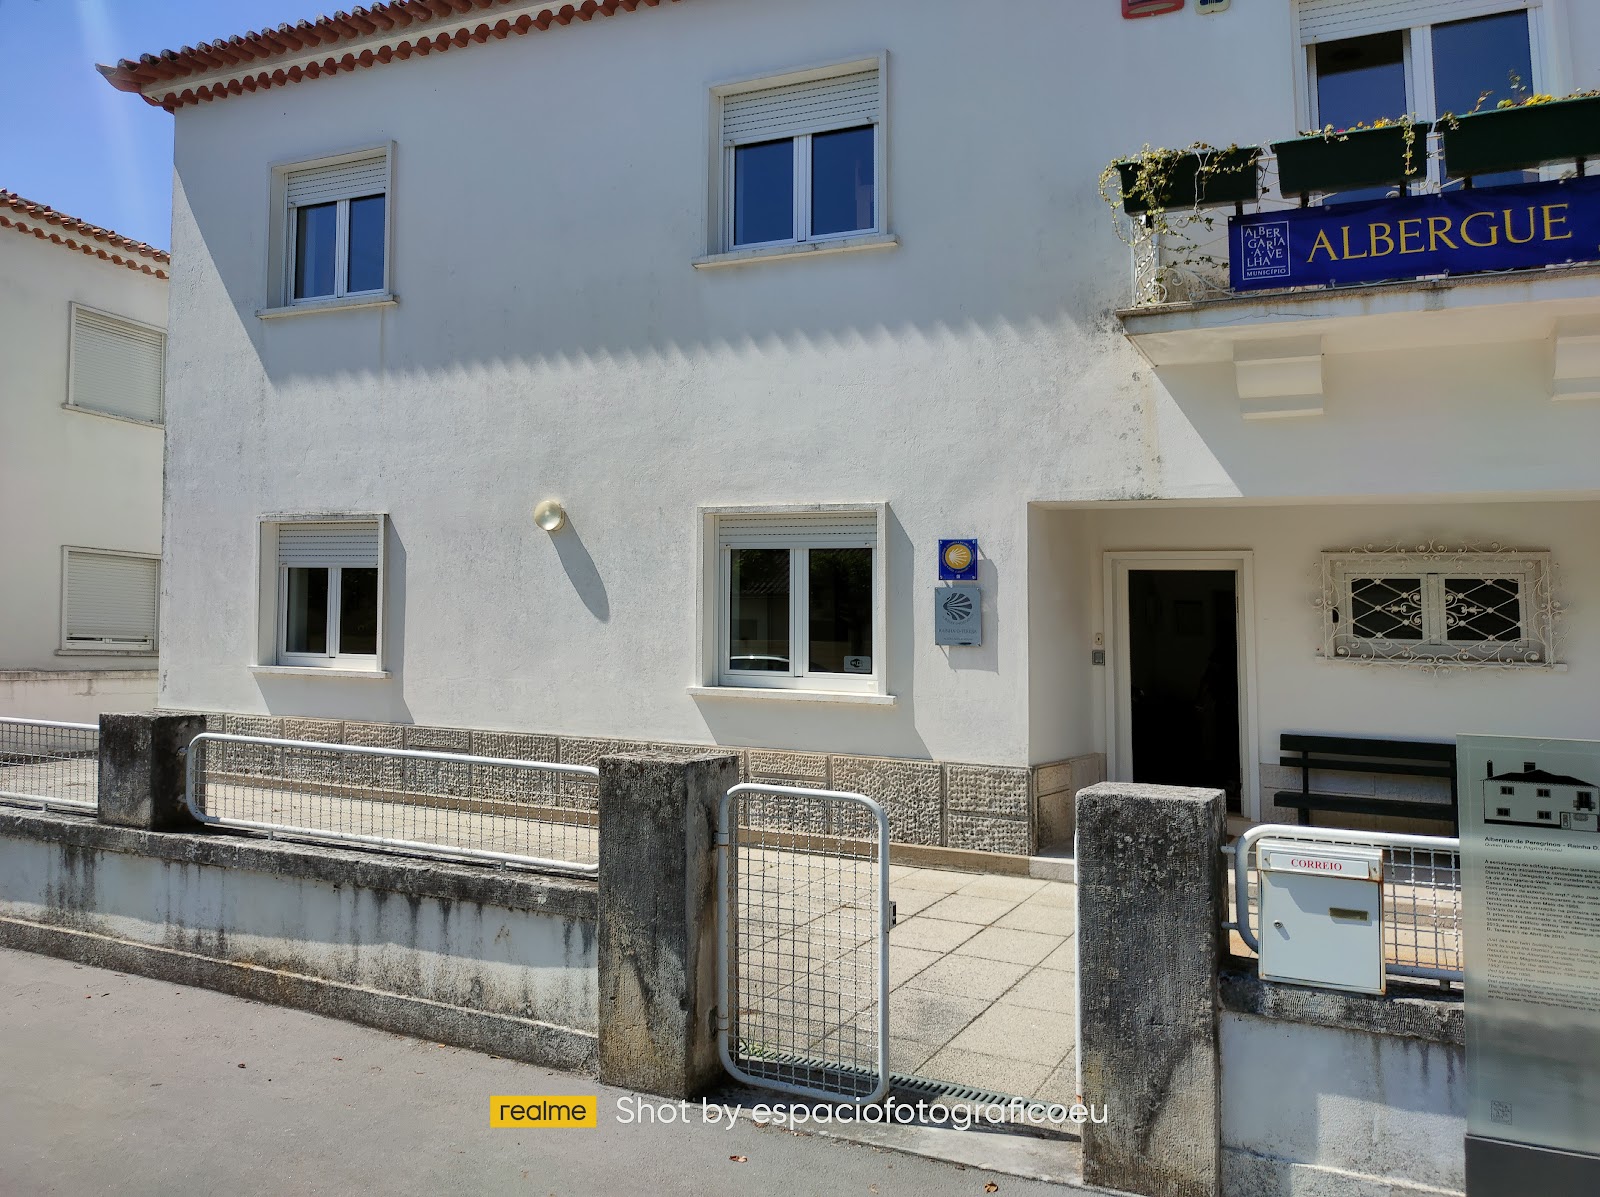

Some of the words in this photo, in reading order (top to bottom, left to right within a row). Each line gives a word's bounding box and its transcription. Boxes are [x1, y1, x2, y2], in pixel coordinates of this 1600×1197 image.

[1244, 226, 1281, 239] ALBER
[1306, 203, 1573, 264] ALBERGUE
[1247, 237, 1286, 250] GARIA
[1266, 249, 1283, 259] VE
[1247, 256, 1270, 267] LHA
[1246, 268, 1286, 277] MUNICÍPIO
[1525, 840, 1561, 848] Peregrinos
[1291, 858, 1343, 872] CORREIO
